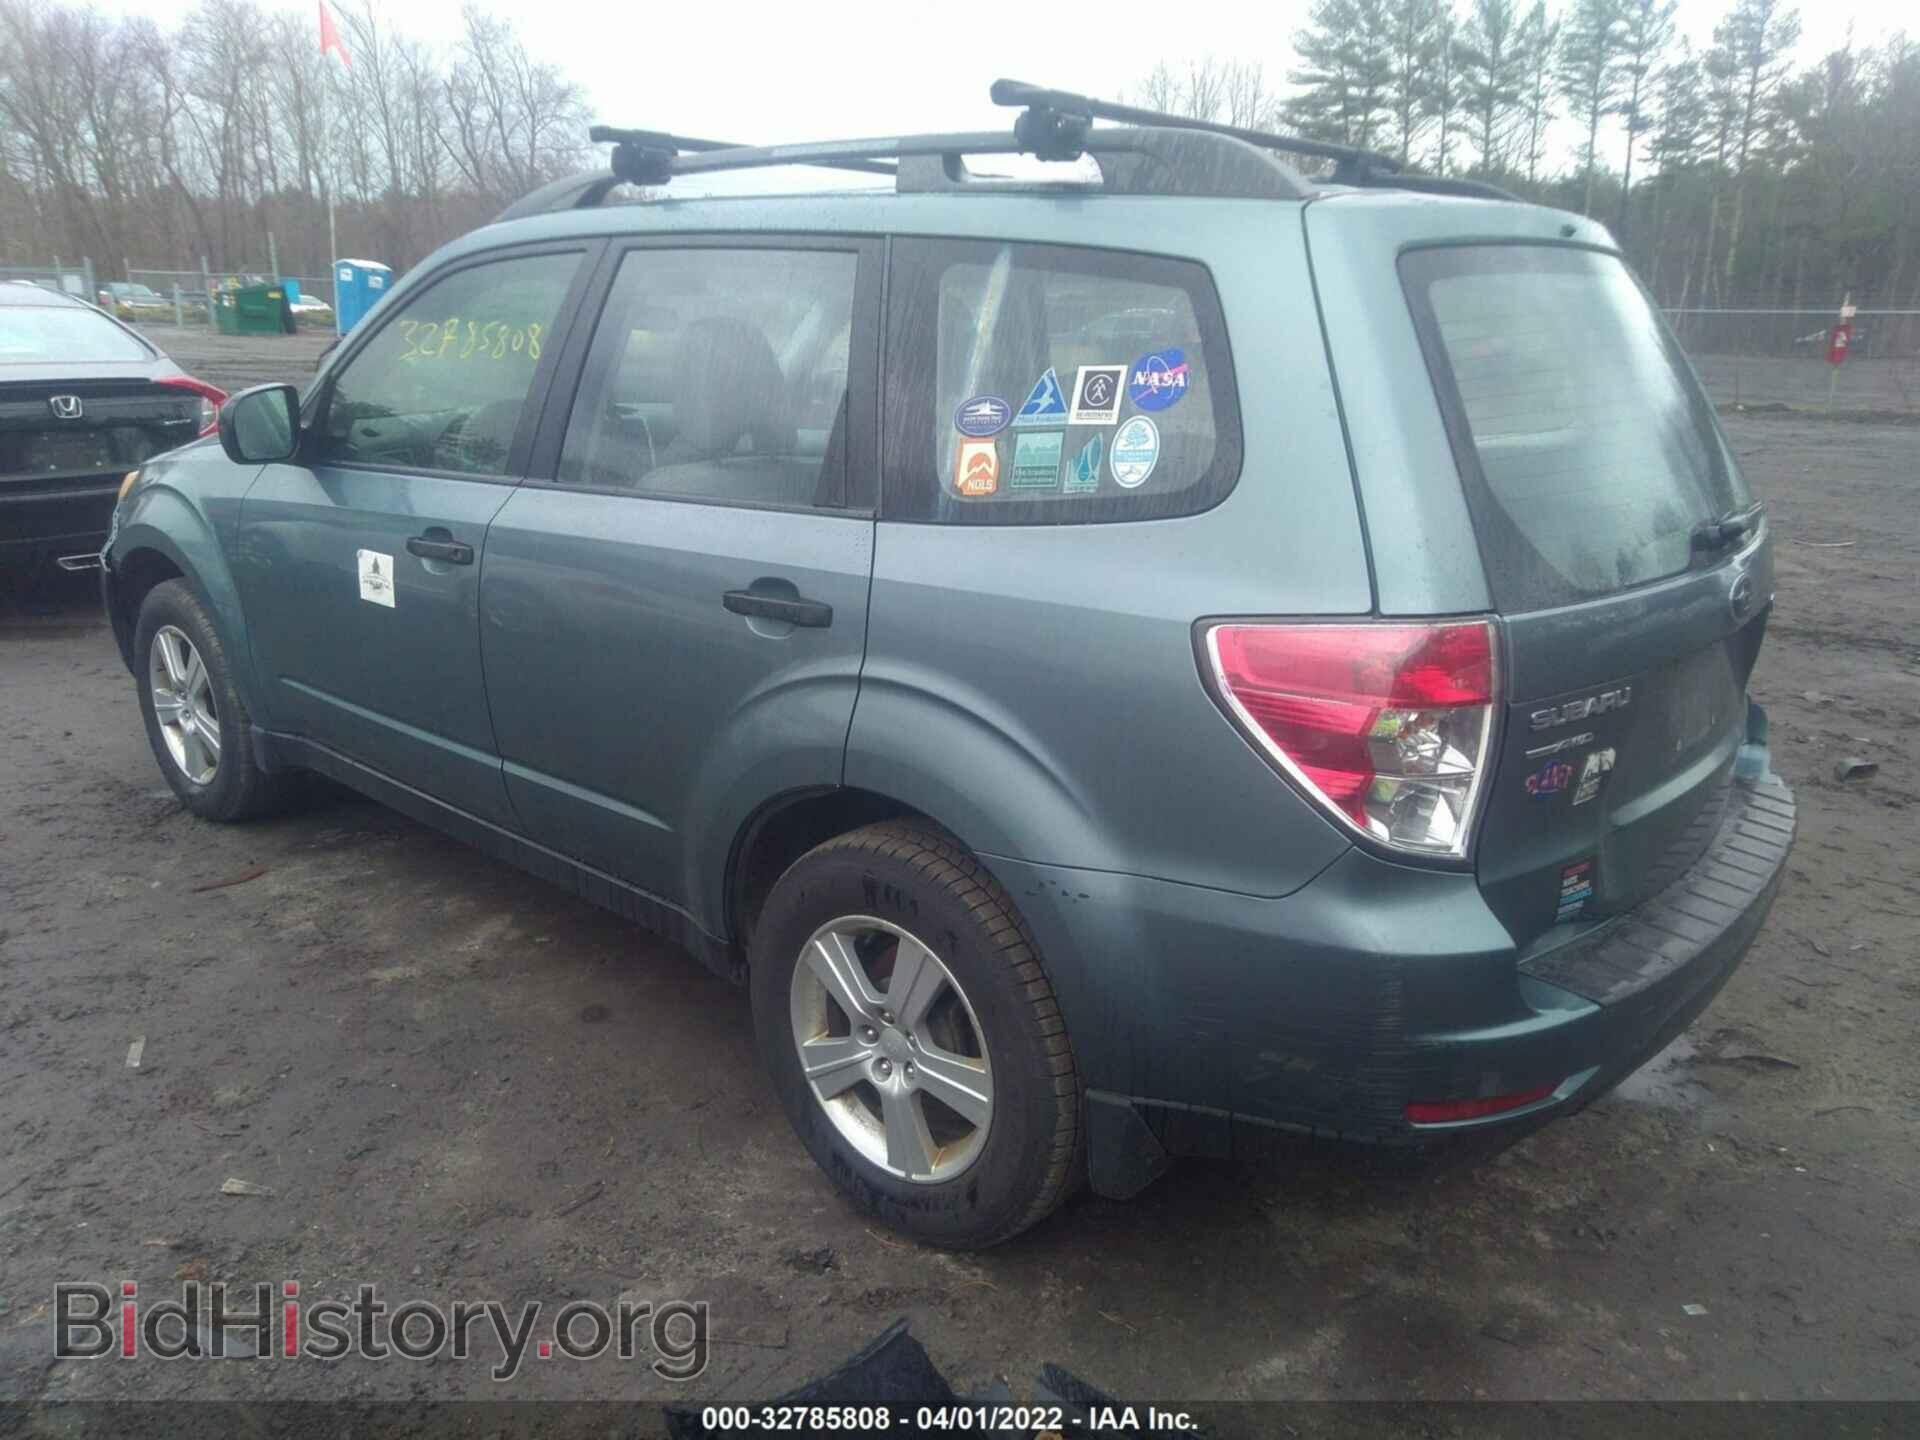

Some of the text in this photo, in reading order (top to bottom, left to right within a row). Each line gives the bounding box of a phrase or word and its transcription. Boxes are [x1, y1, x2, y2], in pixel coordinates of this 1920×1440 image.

[1132, 371, 1185, 387] NASA
[967, 479, 993, 491] NOLS
[1528, 686, 1632, 732] SUBARU
